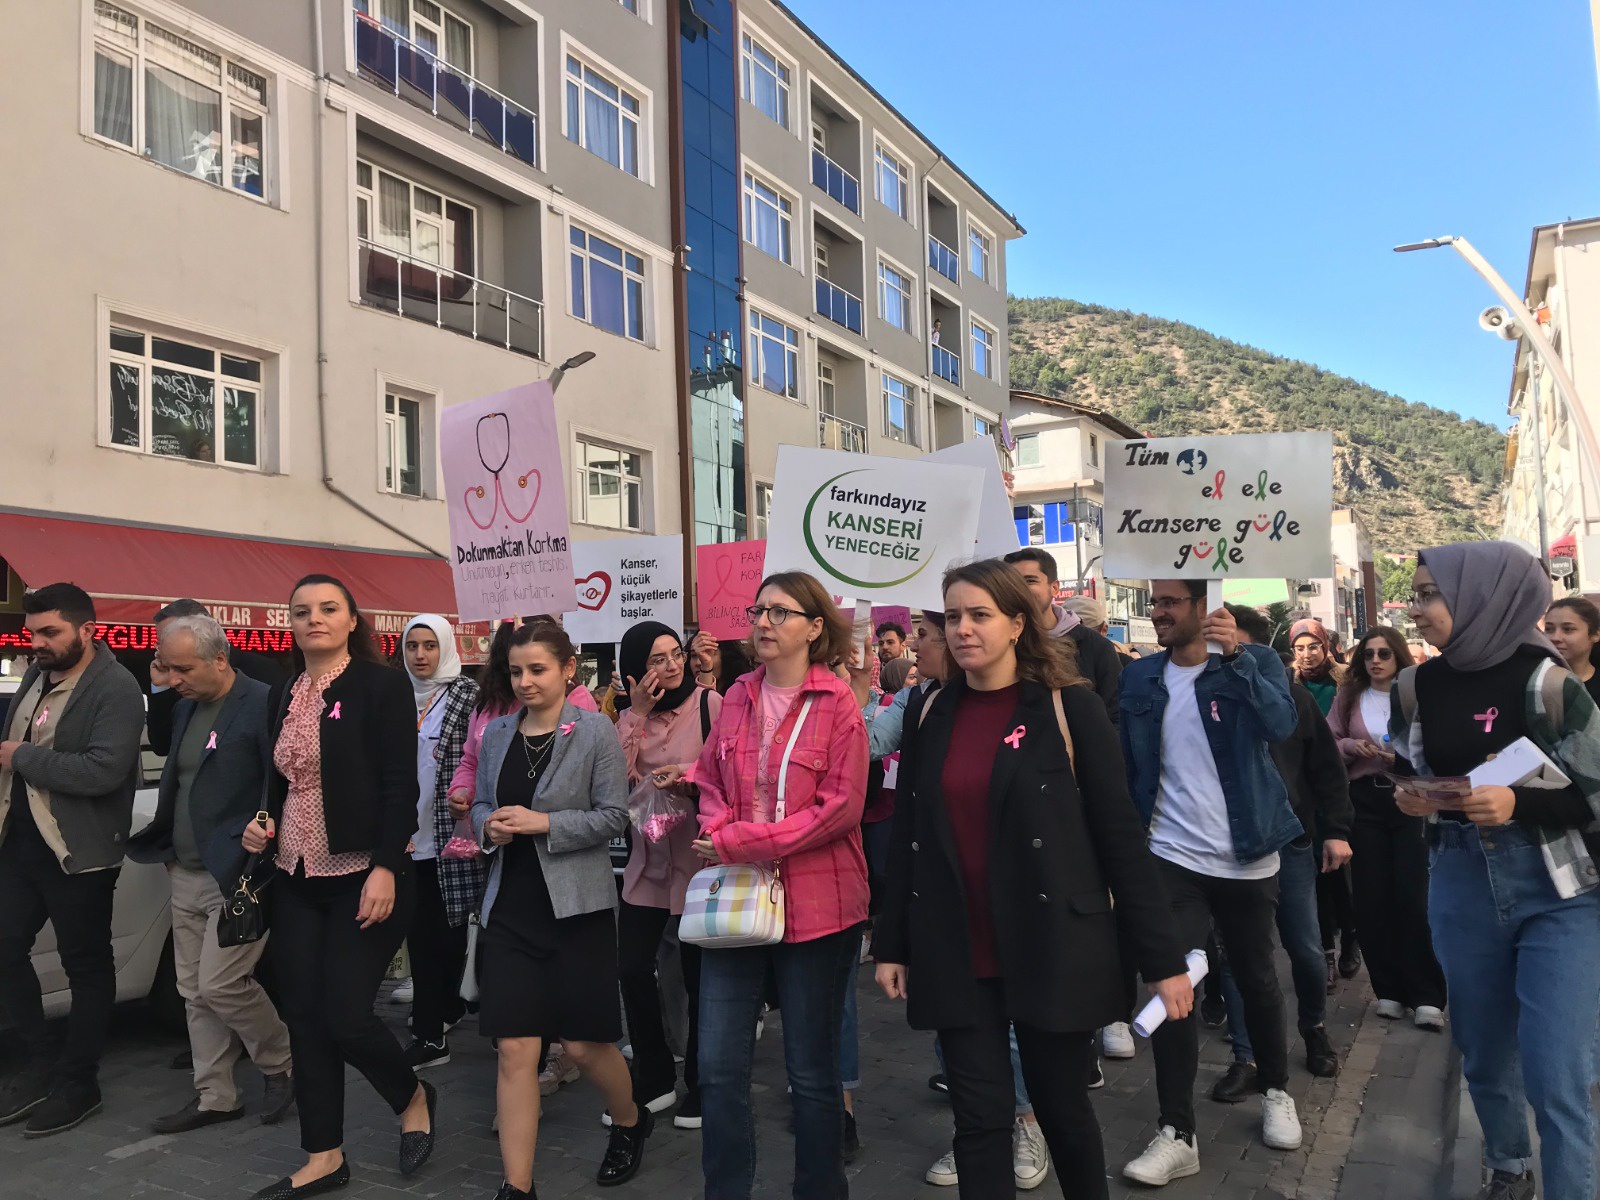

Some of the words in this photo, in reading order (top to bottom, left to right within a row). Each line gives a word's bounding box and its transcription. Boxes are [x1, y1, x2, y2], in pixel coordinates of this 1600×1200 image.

[1125, 442, 1170, 466] Tüm
[830, 486, 927, 514] farkındayız
[827, 510, 923, 540] KANSERİ
[1117, 509, 1221, 534] Kansere
[457, 535, 525, 565] Dokunmaktan
[526, 529, 567, 555] Korkma
[825, 534, 920, 561] YENECEĞİZ
[621, 559, 658, 569] Kanser,
[740, 551, 766, 564] FAR
[621, 574, 651, 587] küçük
[740, 569, 763, 581] KOR
[621, 589, 678, 603] şikayetlerle
[266, 609, 292, 627] SEB
[621, 606, 654, 619] başlar.
[226, 629, 293, 651] MANA
